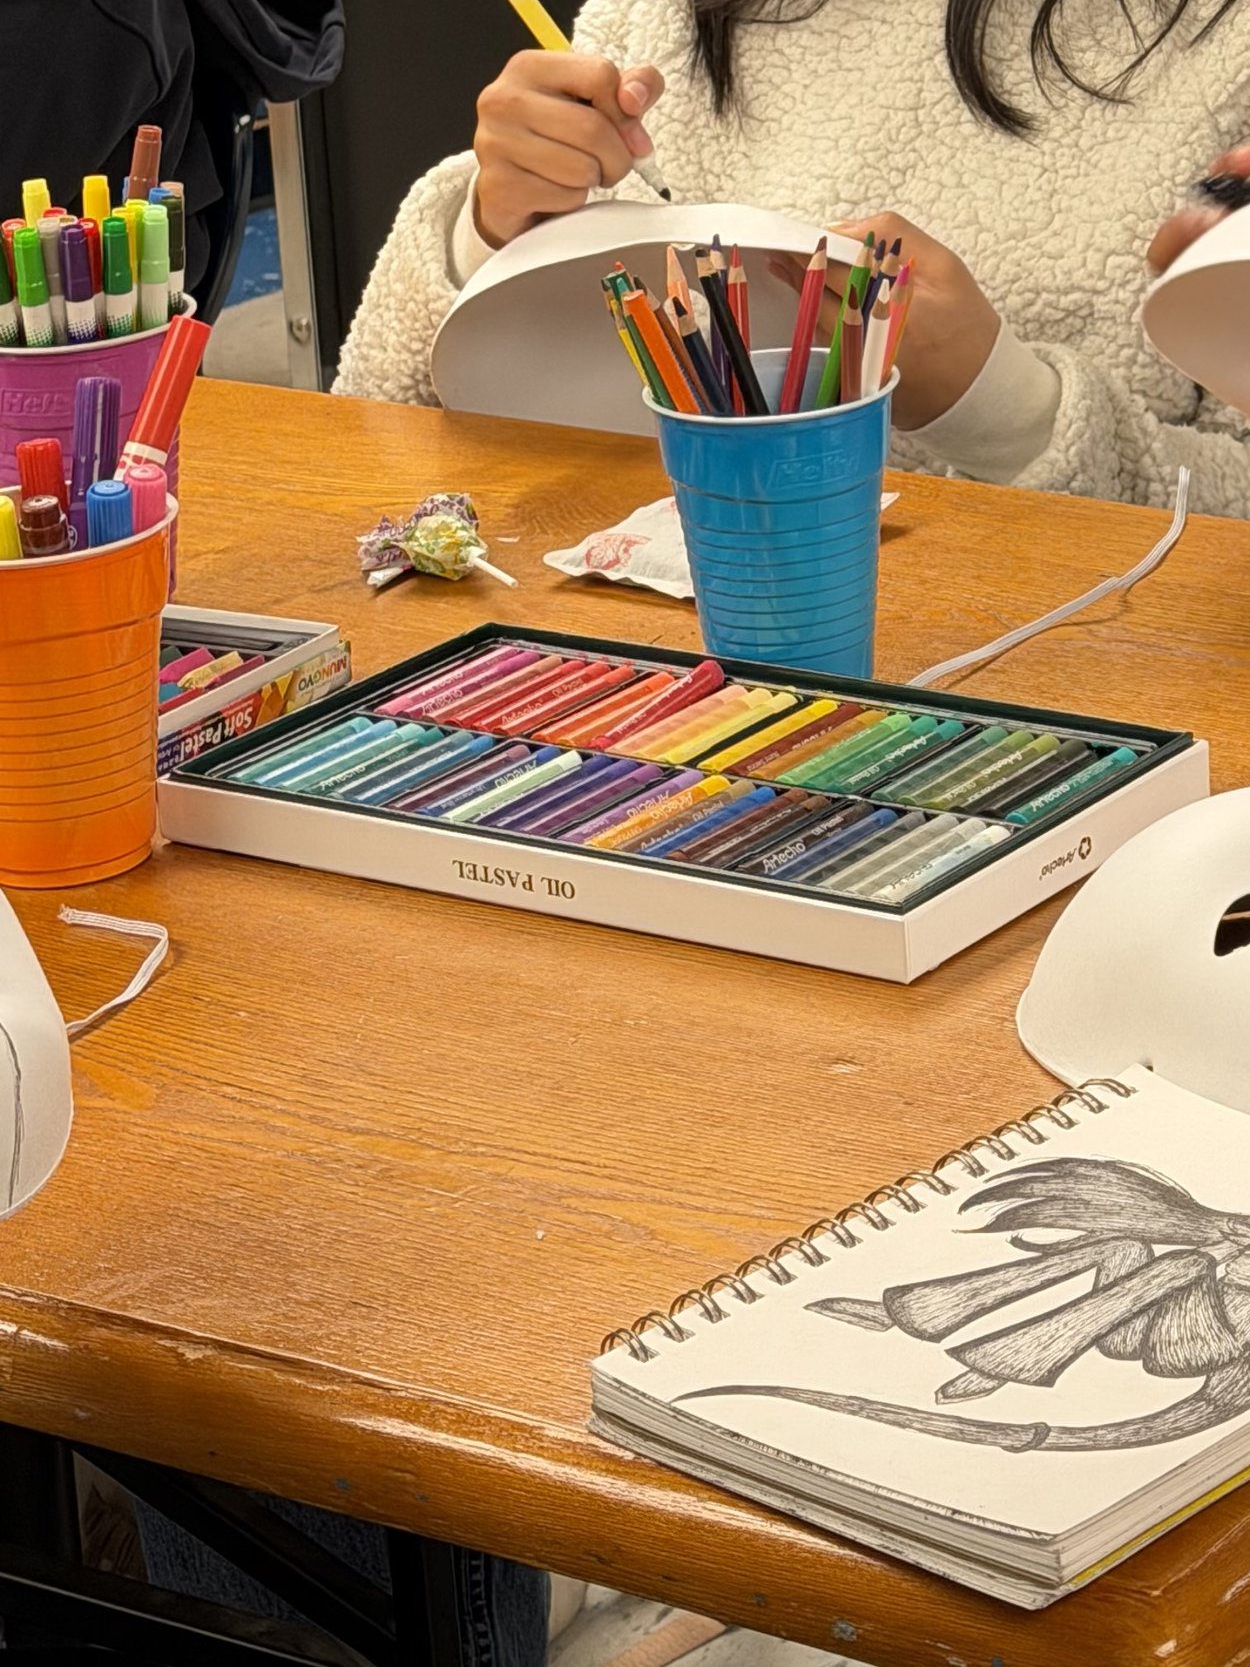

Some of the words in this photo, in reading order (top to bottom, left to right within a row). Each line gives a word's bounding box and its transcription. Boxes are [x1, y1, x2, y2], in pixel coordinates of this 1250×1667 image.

[297, 654, 348, 692] MUNGYO
[224, 705, 254, 735] Soft
[180, 723, 223, 762] Pastel
[759, 839, 807, 874] Artecho
[452, 859, 535, 892] PASTEL
[541, 876, 576, 900] OIL
